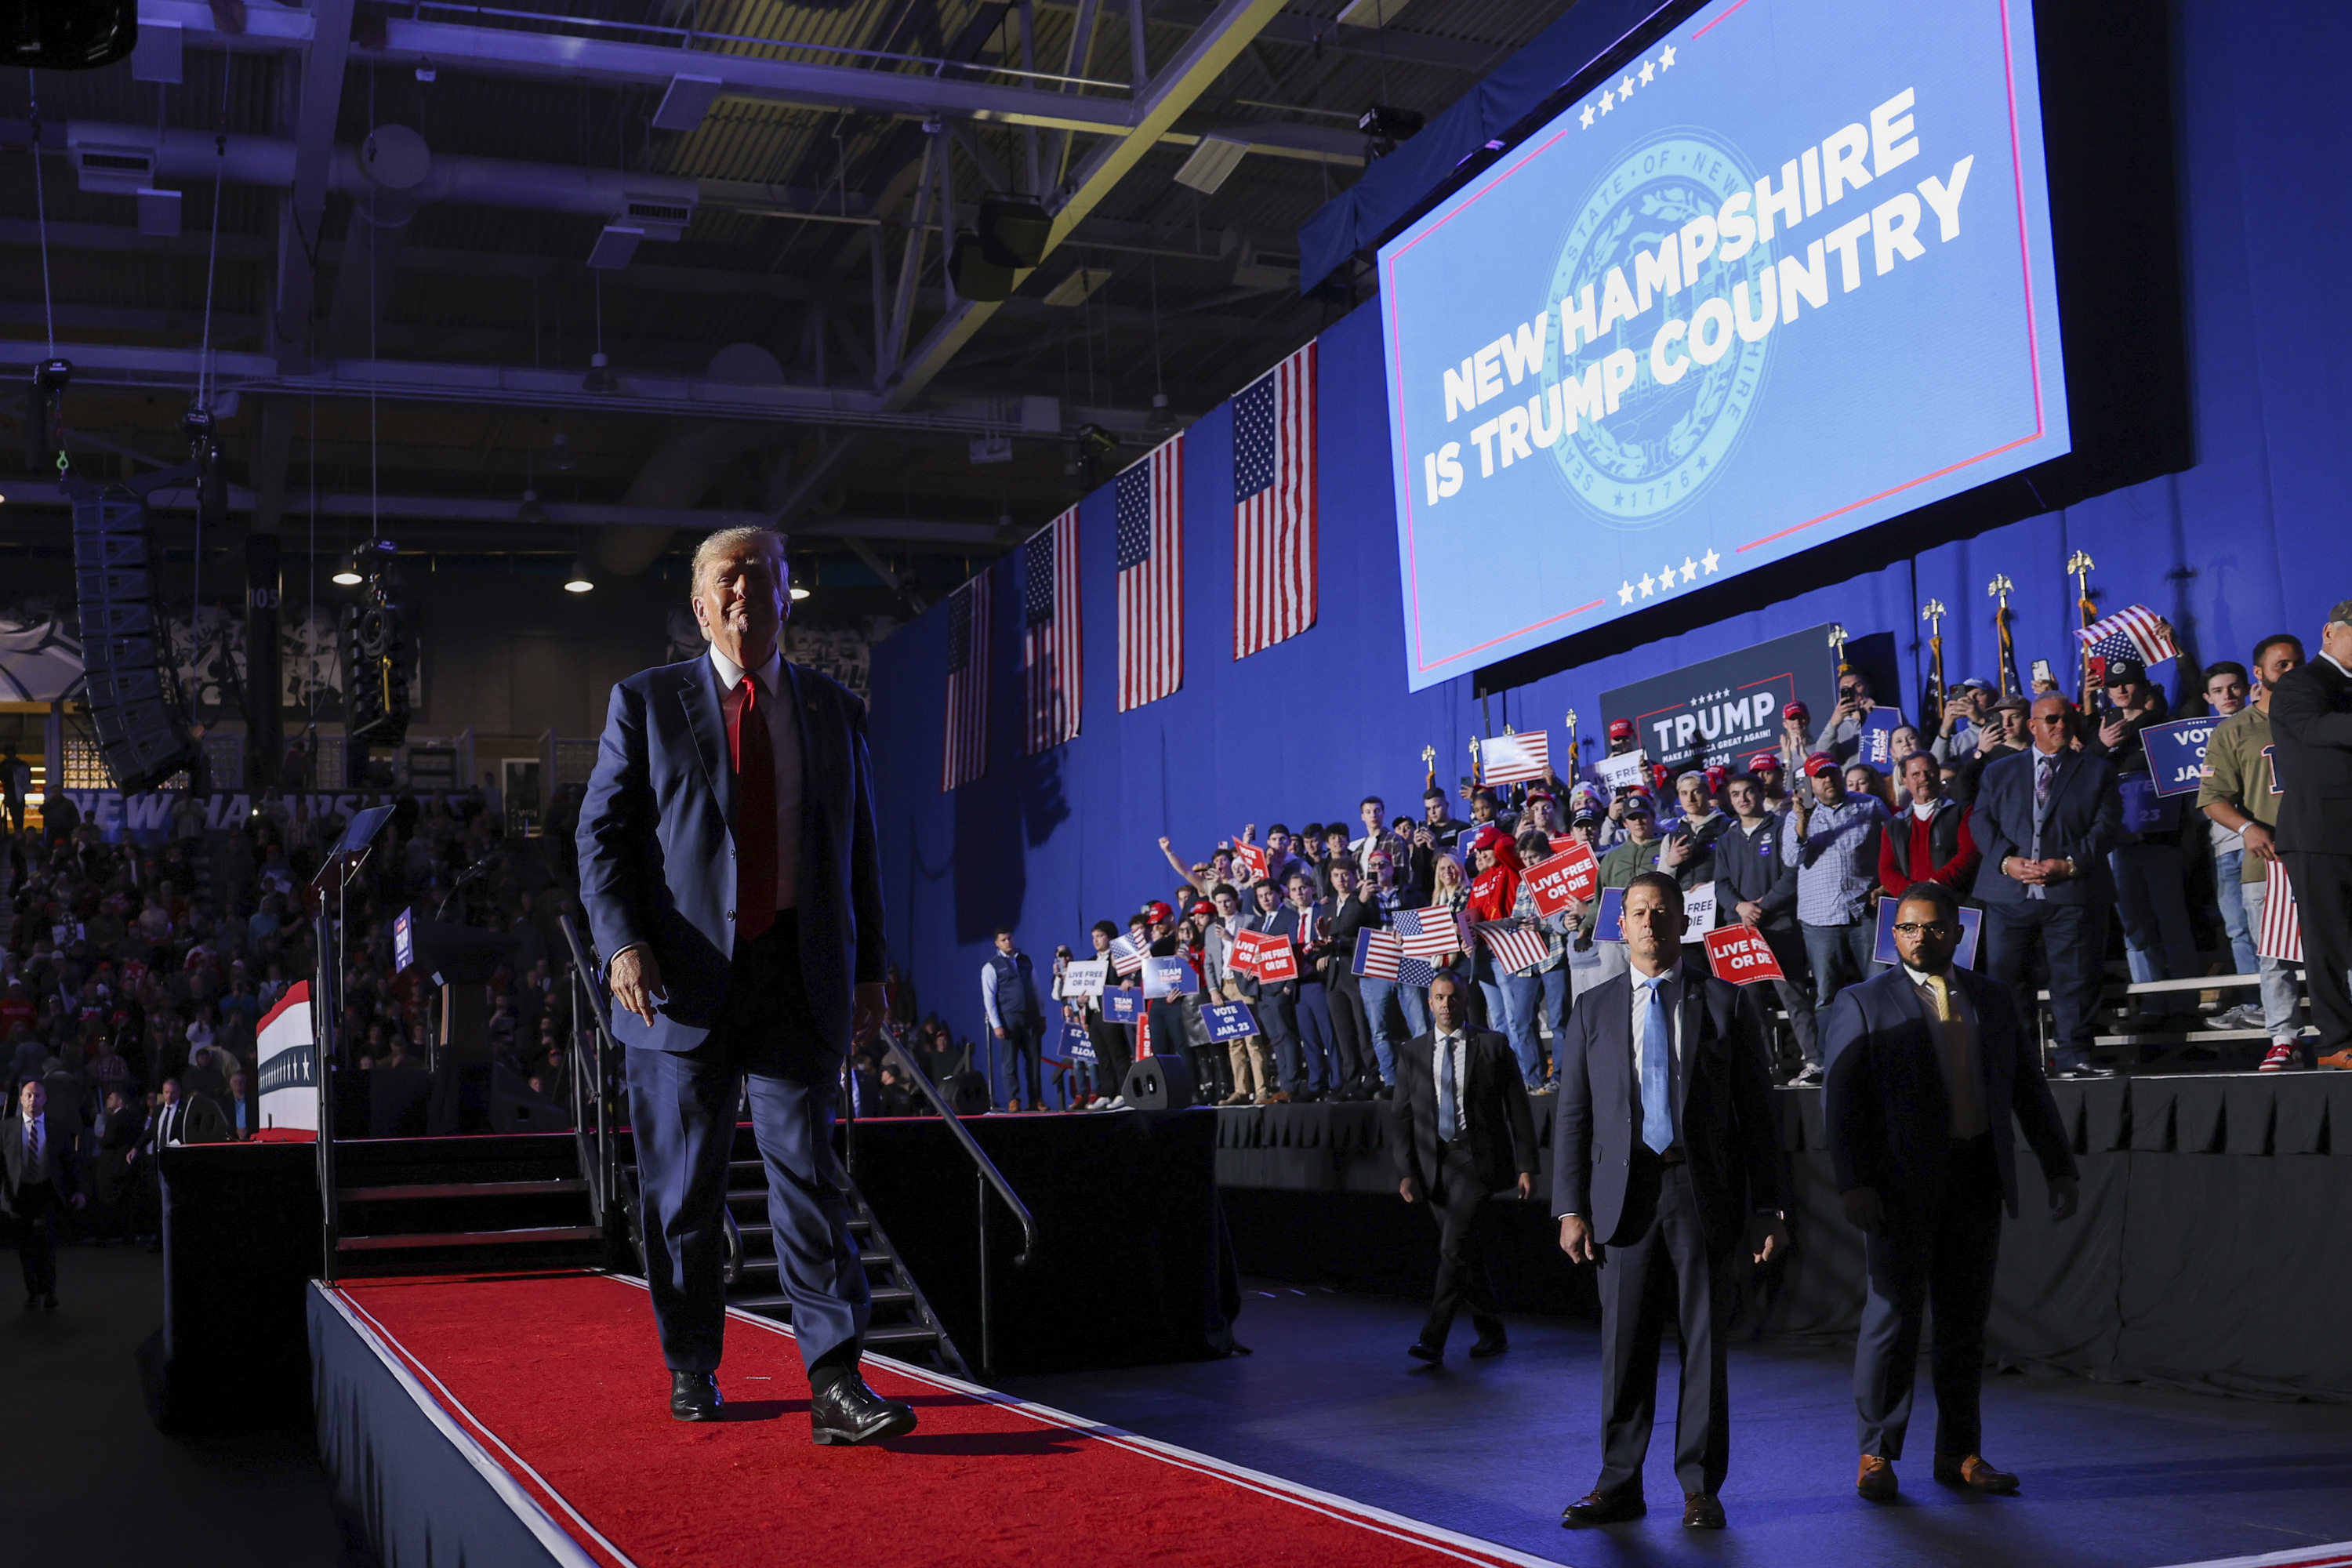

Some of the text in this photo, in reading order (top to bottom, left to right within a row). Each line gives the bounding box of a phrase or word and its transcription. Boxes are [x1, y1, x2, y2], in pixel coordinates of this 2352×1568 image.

[1567, 175, 1624, 261] STATE
[1643, 150, 1670, 174] OF
[1443, 86, 1920, 423] NEW HAMPSHIRE
[1425, 154, 1974, 506] IS TRUMP COUNTRY
[1631, 470, 1690, 509] 1776
[250, 587, 278, 609] 105
[1653, 691, 1775, 752] TRUMP
[1662, 751, 1683, 764] MAKE
[1717, 736, 1742, 750] GREAT
[1744, 728, 1771, 743] AGAIN!
[1871, 728, 1881, 762] TEAM
[1878, 729, 1887, 763] TRUMP
[1702, 753, 1730, 769] 2024
[1616, 765, 1639, 780] FRE
[2118, 779, 2154, 795] OTE
[1530, 858, 1594, 892] LIVE FREE
[1548, 874, 1590, 899] OR DIE
[1687, 899, 1713, 913] FREE
[1236, 940, 1255, 953] LIVE
[1272, 946, 1291, 959] FREE
[1713, 940, 1750, 959] LIVE
[1239, 952, 1252, 963] OR
[1265, 958, 1289, 971] OR DIE
[1730, 952, 1773, 969] OR DIE
[1085, 970, 1103, 978] FREE
[1212, 1005, 1238, 1017] VOTE
[1069, 1029, 1083, 1038] 23
[1217, 1022, 1250, 1036] JAN. 23
[1071, 1045, 1096, 1058] VOTE
